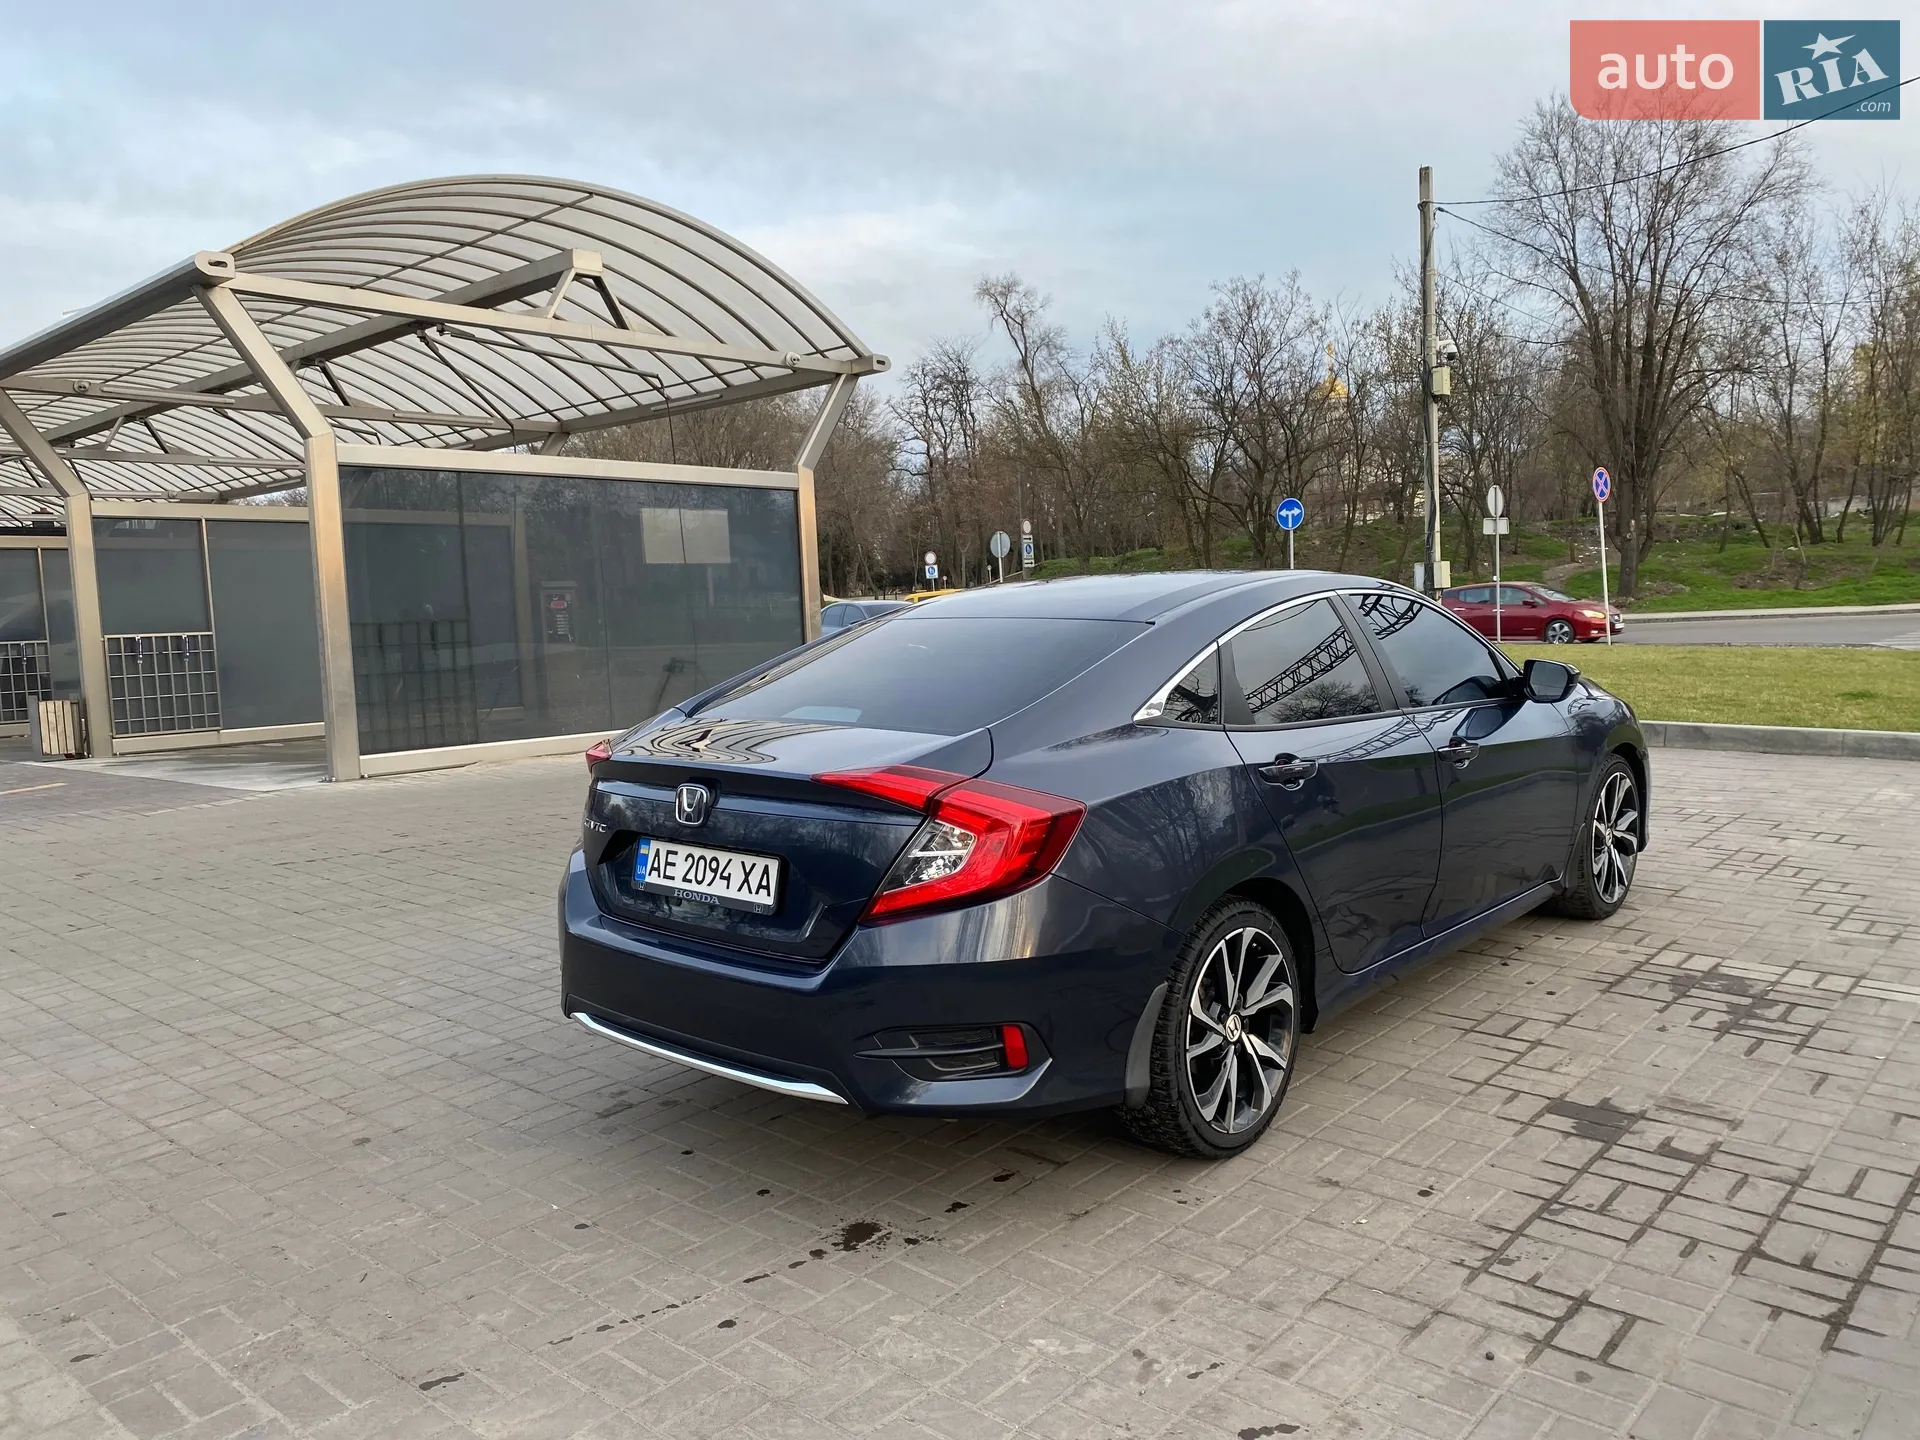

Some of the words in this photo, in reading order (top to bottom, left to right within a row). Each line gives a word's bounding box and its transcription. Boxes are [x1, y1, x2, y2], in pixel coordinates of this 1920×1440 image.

[637, 865, 646, 875] UA
[648, 848, 678, 881] AE
[681, 852, 733, 890] 2094
[737, 860, 771, 897] XA
[673, 888, 720, 905] HONDA
